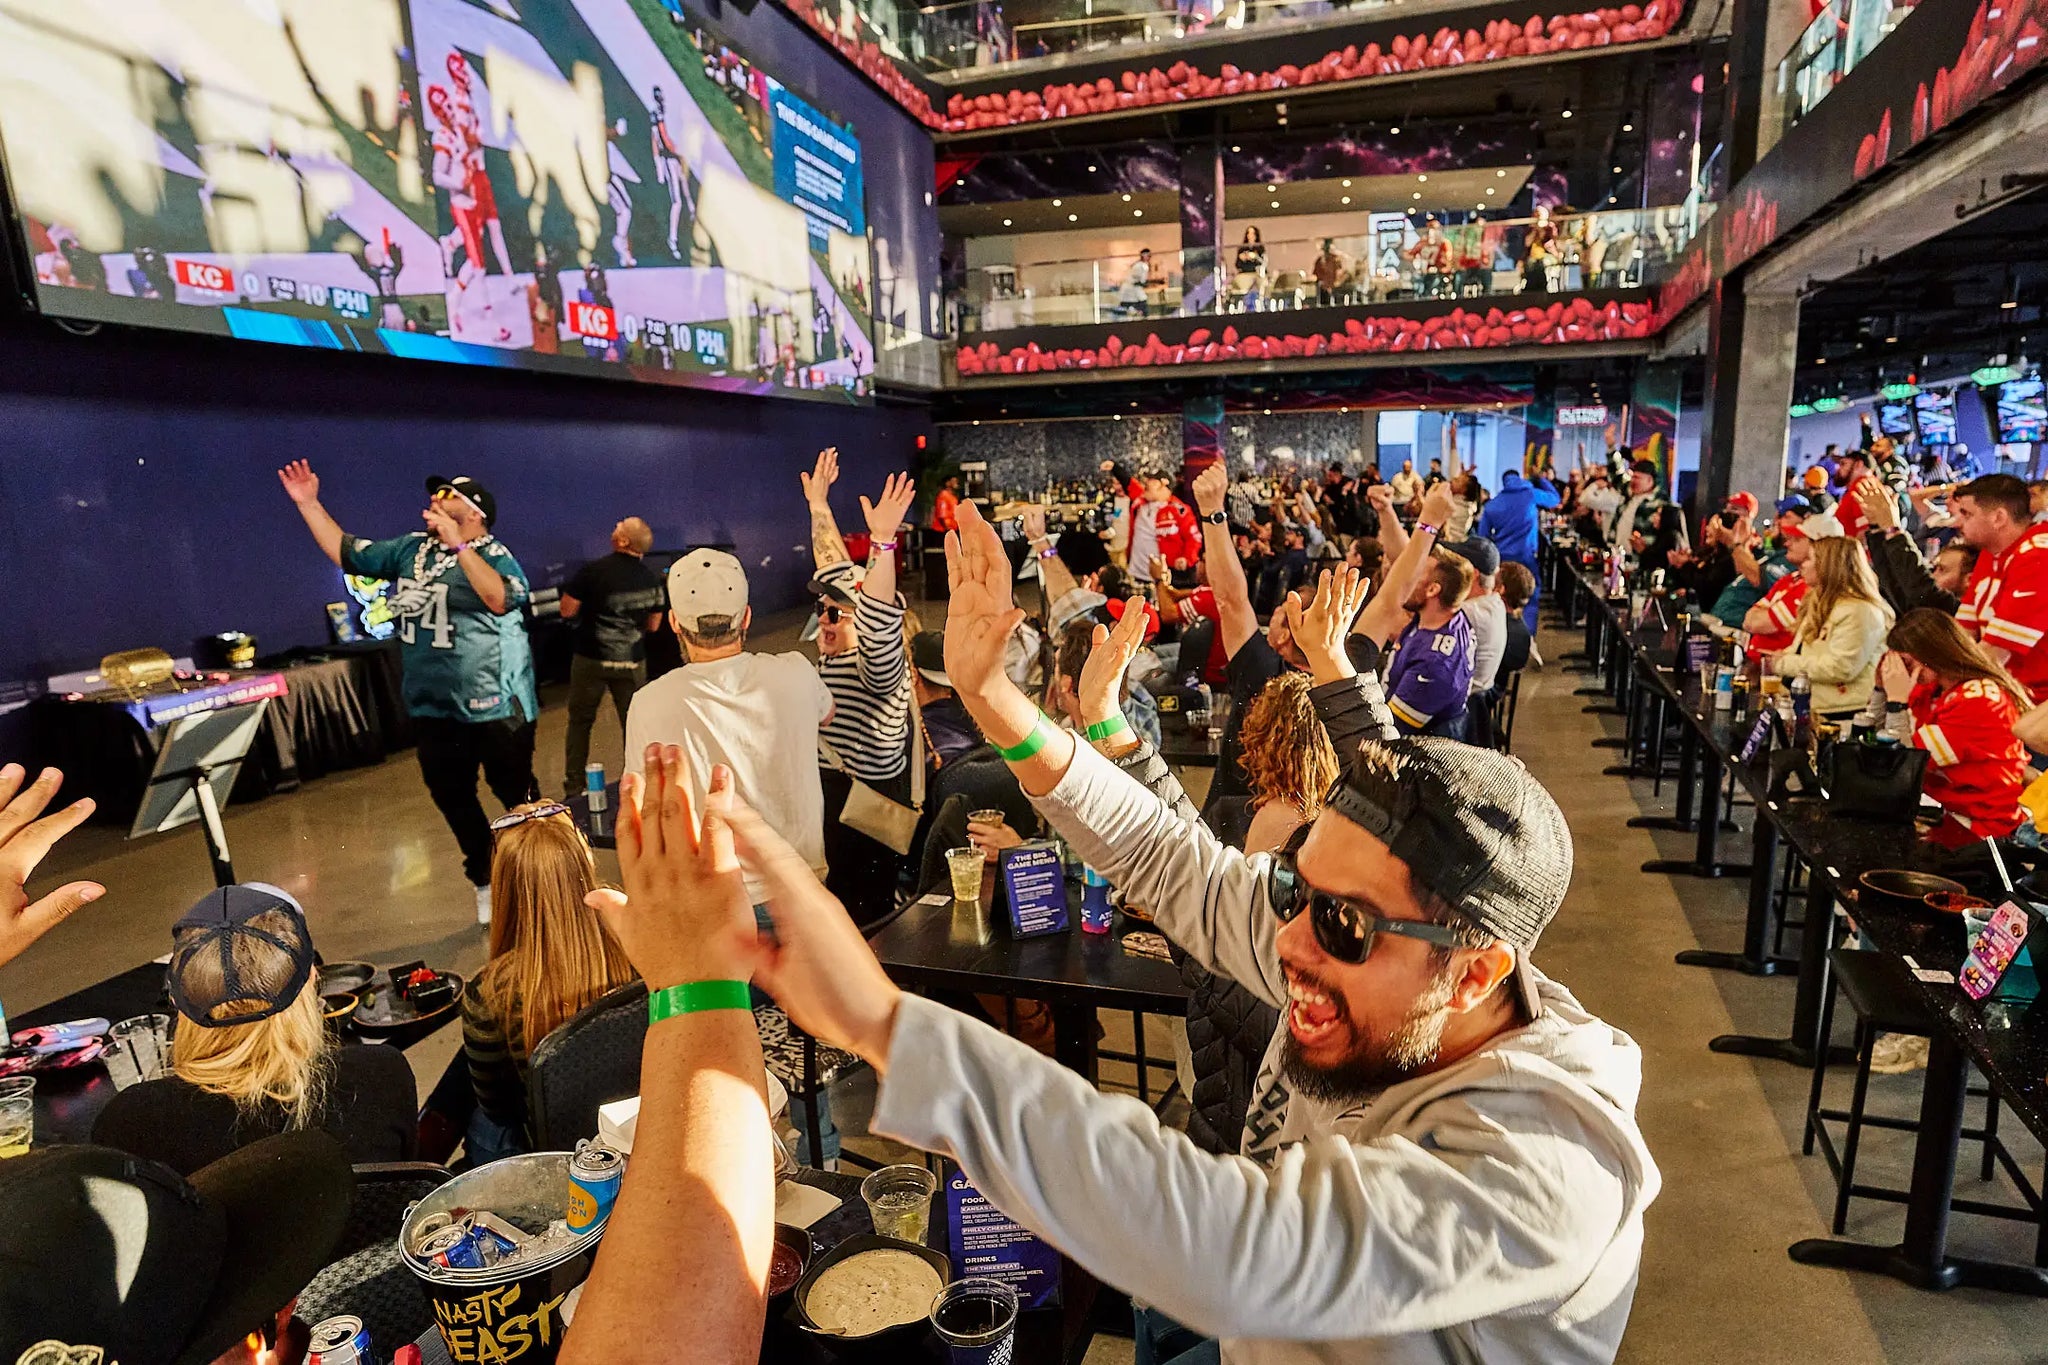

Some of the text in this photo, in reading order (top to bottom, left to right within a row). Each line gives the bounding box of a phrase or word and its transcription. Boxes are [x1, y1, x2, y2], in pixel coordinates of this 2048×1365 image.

[186, 263, 224, 289] KC
[243, 273, 258, 295] 0
[302, 283, 326, 306] 10
[333, 287, 369, 313] PHI
[577, 305, 609, 335] KC
[624, 316, 638, 342] 0
[670, 323, 692, 352] 10
[695, 328, 725, 356] PHI
[1431, 633, 1457, 657] 18
[1007, 856, 1056, 870] GAME MENU
[1014, 854, 1032, 862] THE
[951, 1180, 975, 1190] GA
[962, 1204, 989, 1212] KANSAS
[986, 1223, 1024, 1231] CHEESEST
[965, 1256, 997, 1264] DRINKS
[979, 1263, 1018, 1271] THREEPEAT
[432, 1282, 521, 1326] NASTY
